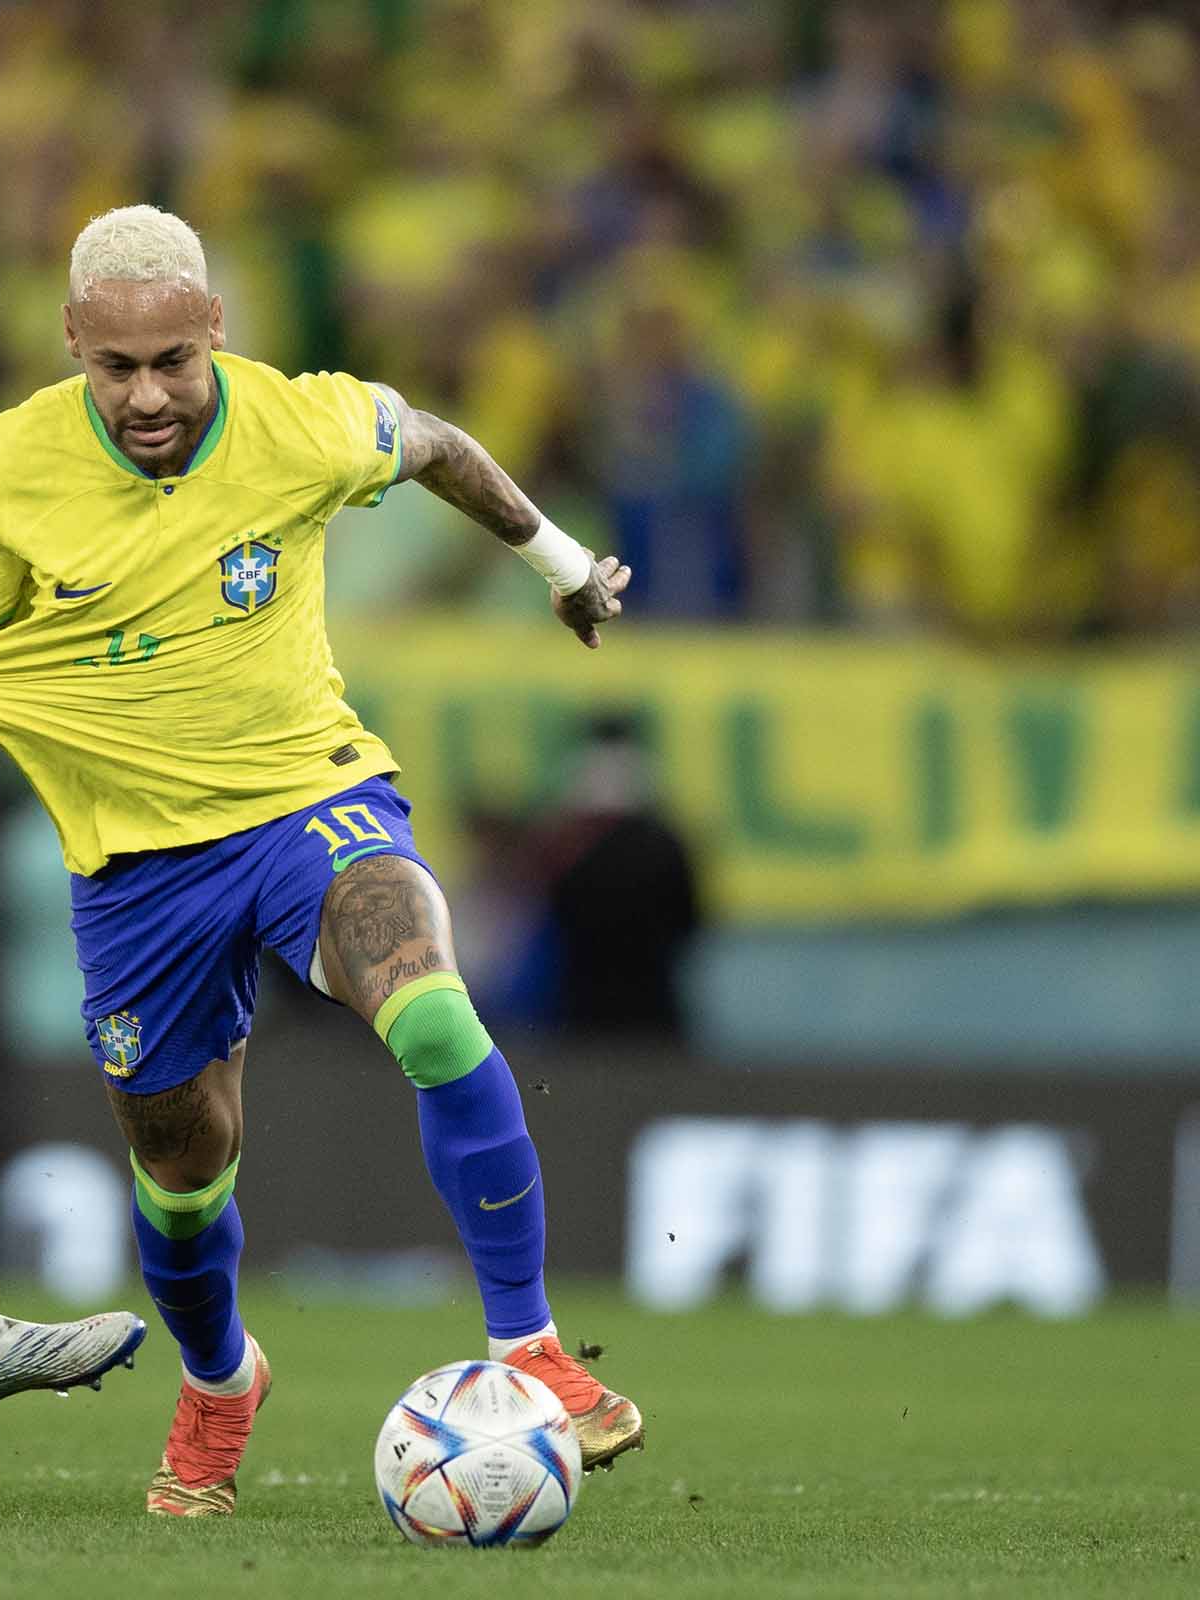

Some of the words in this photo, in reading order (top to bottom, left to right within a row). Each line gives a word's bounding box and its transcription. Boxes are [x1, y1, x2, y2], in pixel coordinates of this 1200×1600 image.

[237, 569, 262, 580] CBF
[304, 803, 395, 855] 10
[627, 1118, 1103, 1314] FIFA
